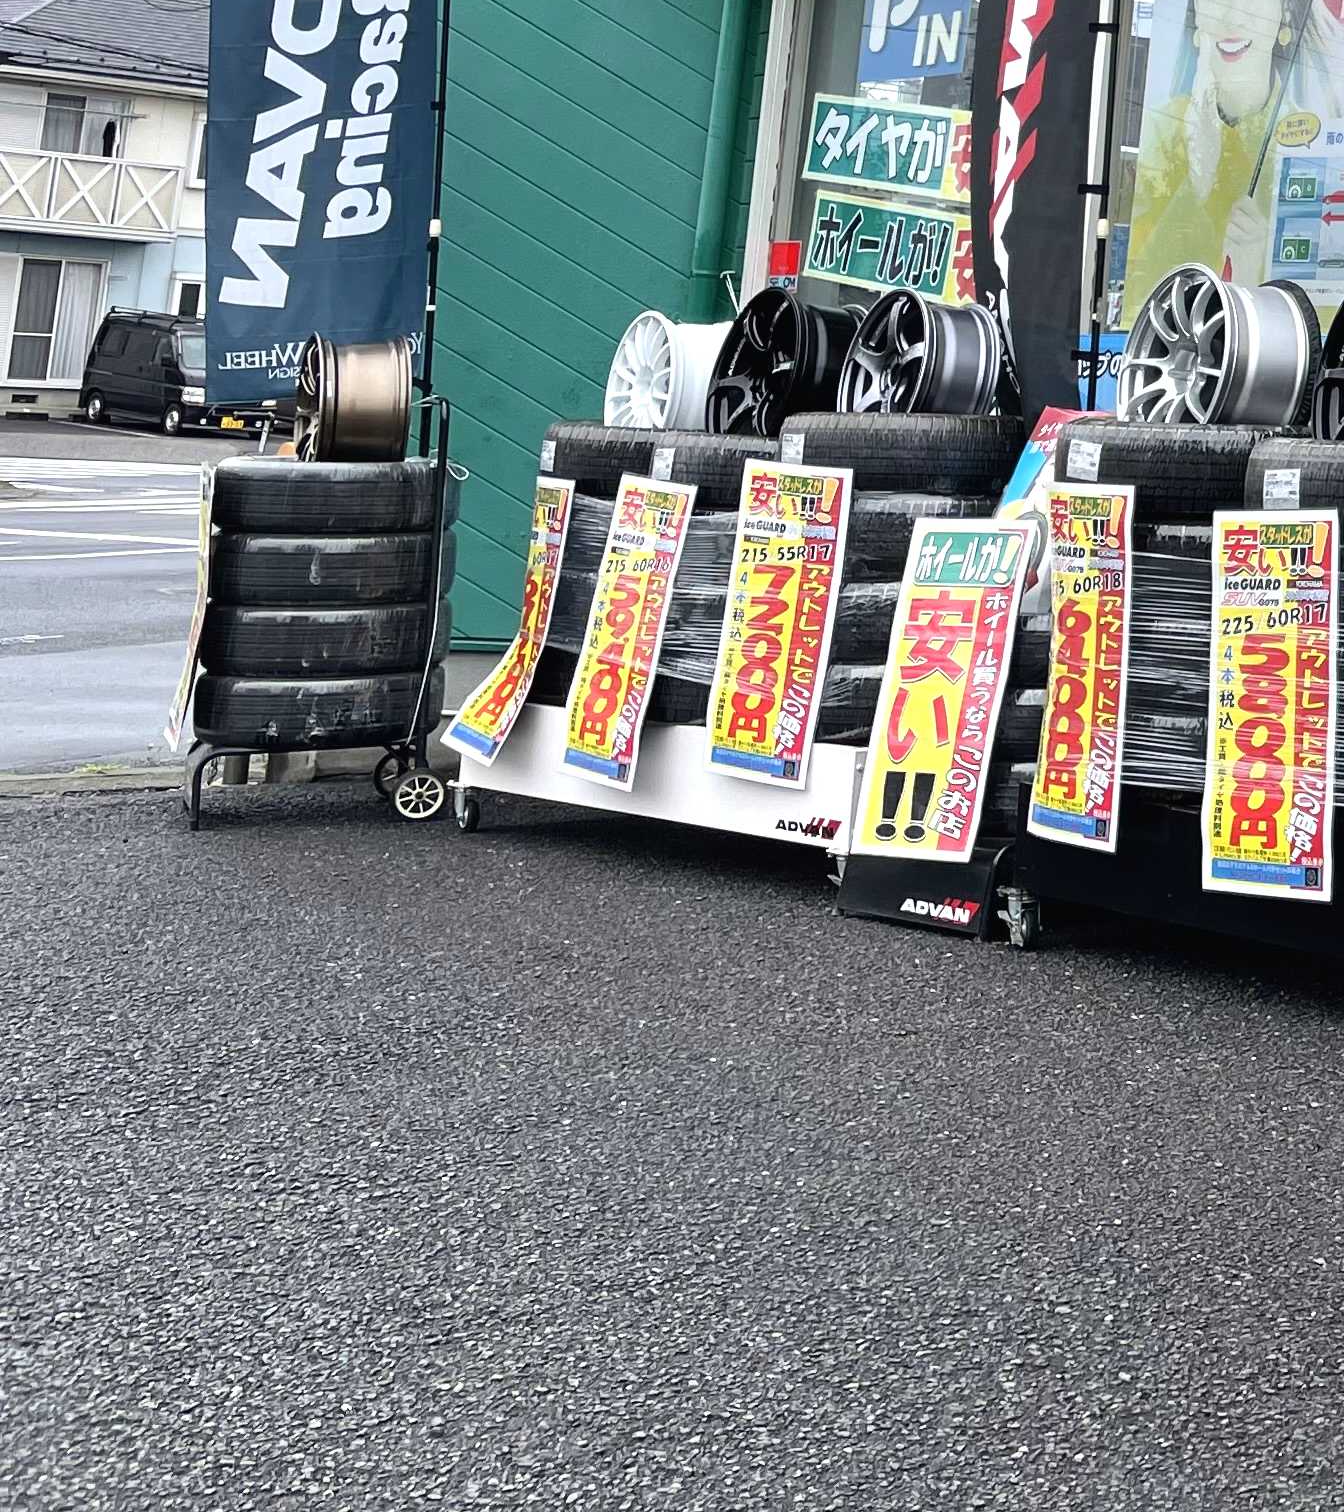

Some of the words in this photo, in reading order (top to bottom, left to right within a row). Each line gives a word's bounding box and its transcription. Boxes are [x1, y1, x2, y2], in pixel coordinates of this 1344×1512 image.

[912, 9, 962, 67] IN
[815, 105, 947, 184] タイヤが
[812, 203, 951, 288] ホイールが!
[915, 533, 1022, 587] ホイールが!
[900, 897, 972, 922] ADVAN
